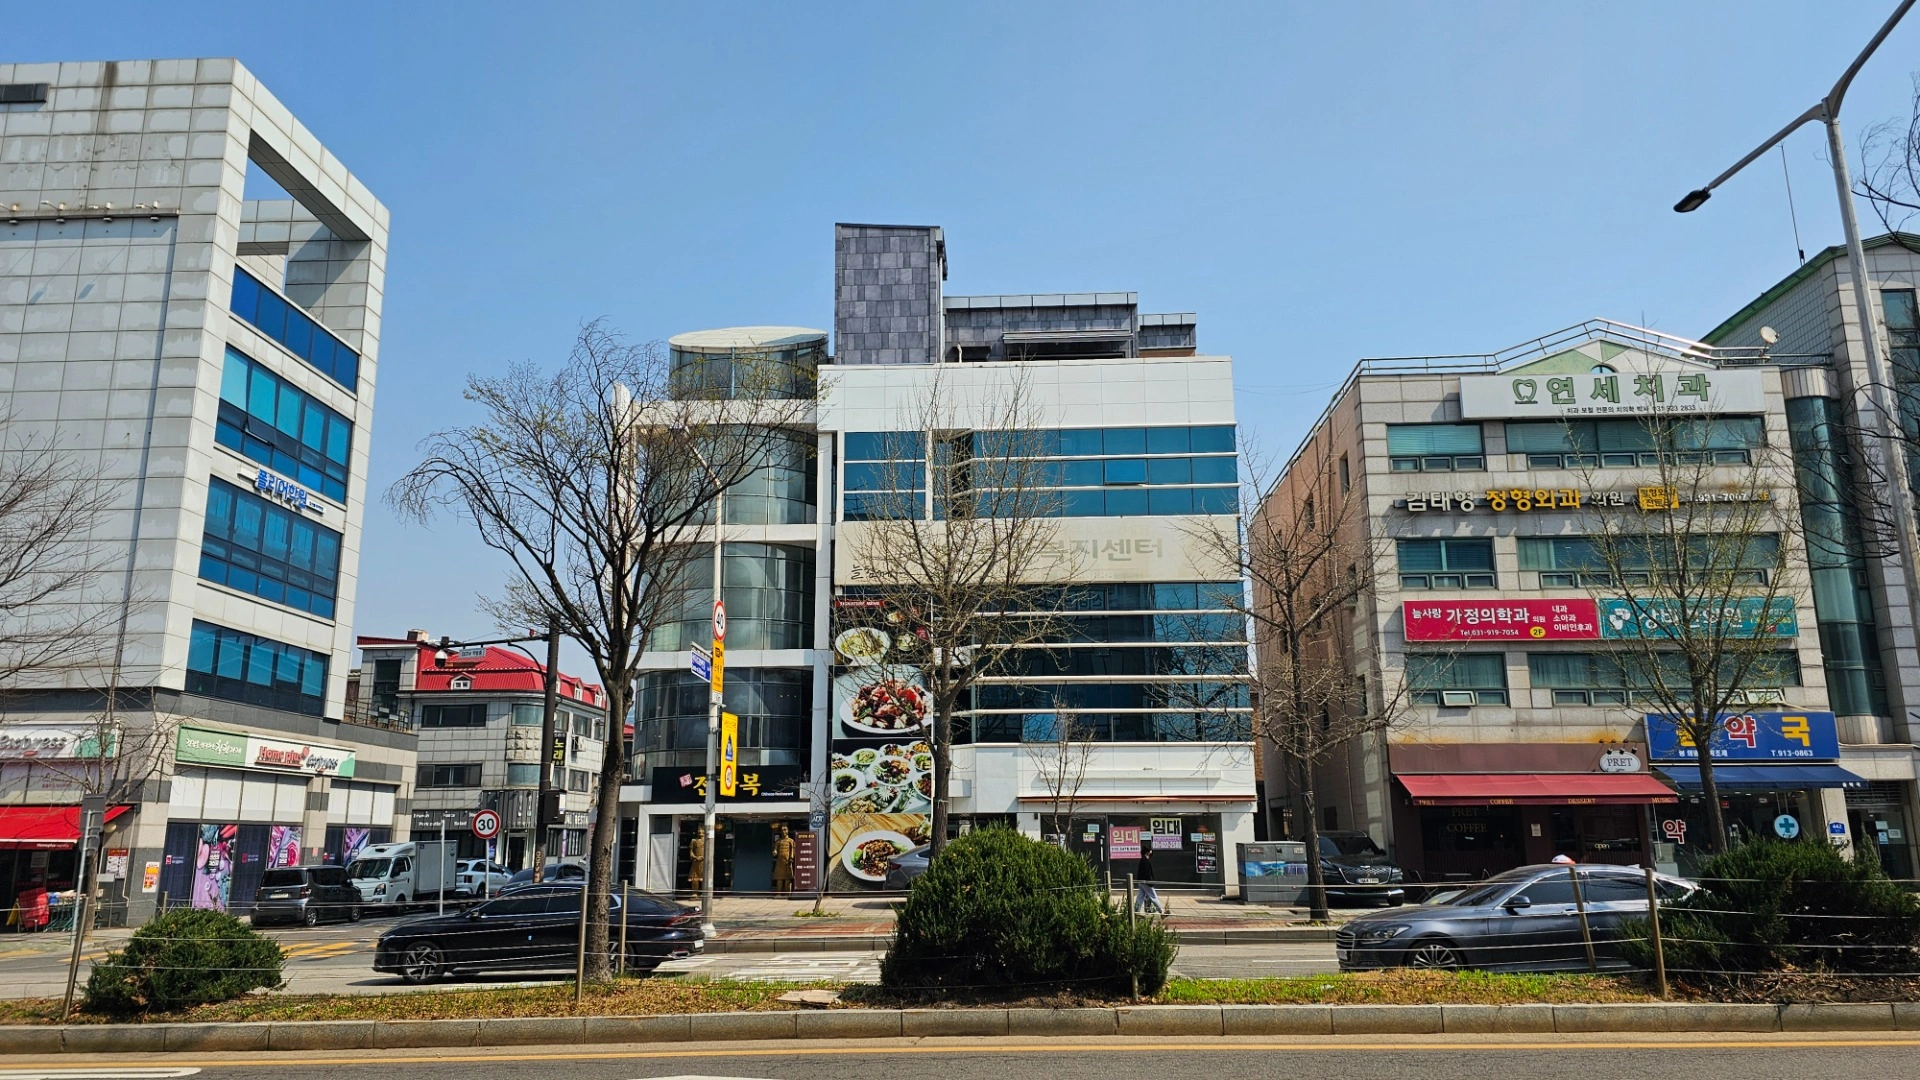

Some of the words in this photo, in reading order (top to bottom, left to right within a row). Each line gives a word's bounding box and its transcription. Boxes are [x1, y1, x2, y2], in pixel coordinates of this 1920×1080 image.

[1547, 374, 1711, 404] 연세치과
[1596, 406, 1615, 414] 전문의
[1617, 405, 1635, 413] 치의학
[258, 469, 307, 510] 폴리어학원
[1406, 490, 1475, 512] 김태형
[1485, 489, 1581, 512] 정형외과
[1591, 491, 1625, 507] 의원
[716, 613, 724, 629] 40
[1447, 607, 1530, 625] 가정의학과
[1532, 615, 1546, 623] 의원
[1552, 604, 1568, 613] 내과
[1553, 614, 1577, 623] 소아과
[1554, 623, 1593, 633] 이비인후과
[1607, 757, 1633, 767] PRET
[693, 773, 761, 796] 전복
[478, 818, 496, 831] 30
[1152, 820, 1181, 835] 임대
[1446, 823, 1488, 833] COFFEE
[1663, 819, 1687, 844] 약
[1112, 829, 1139, 844] 임대
